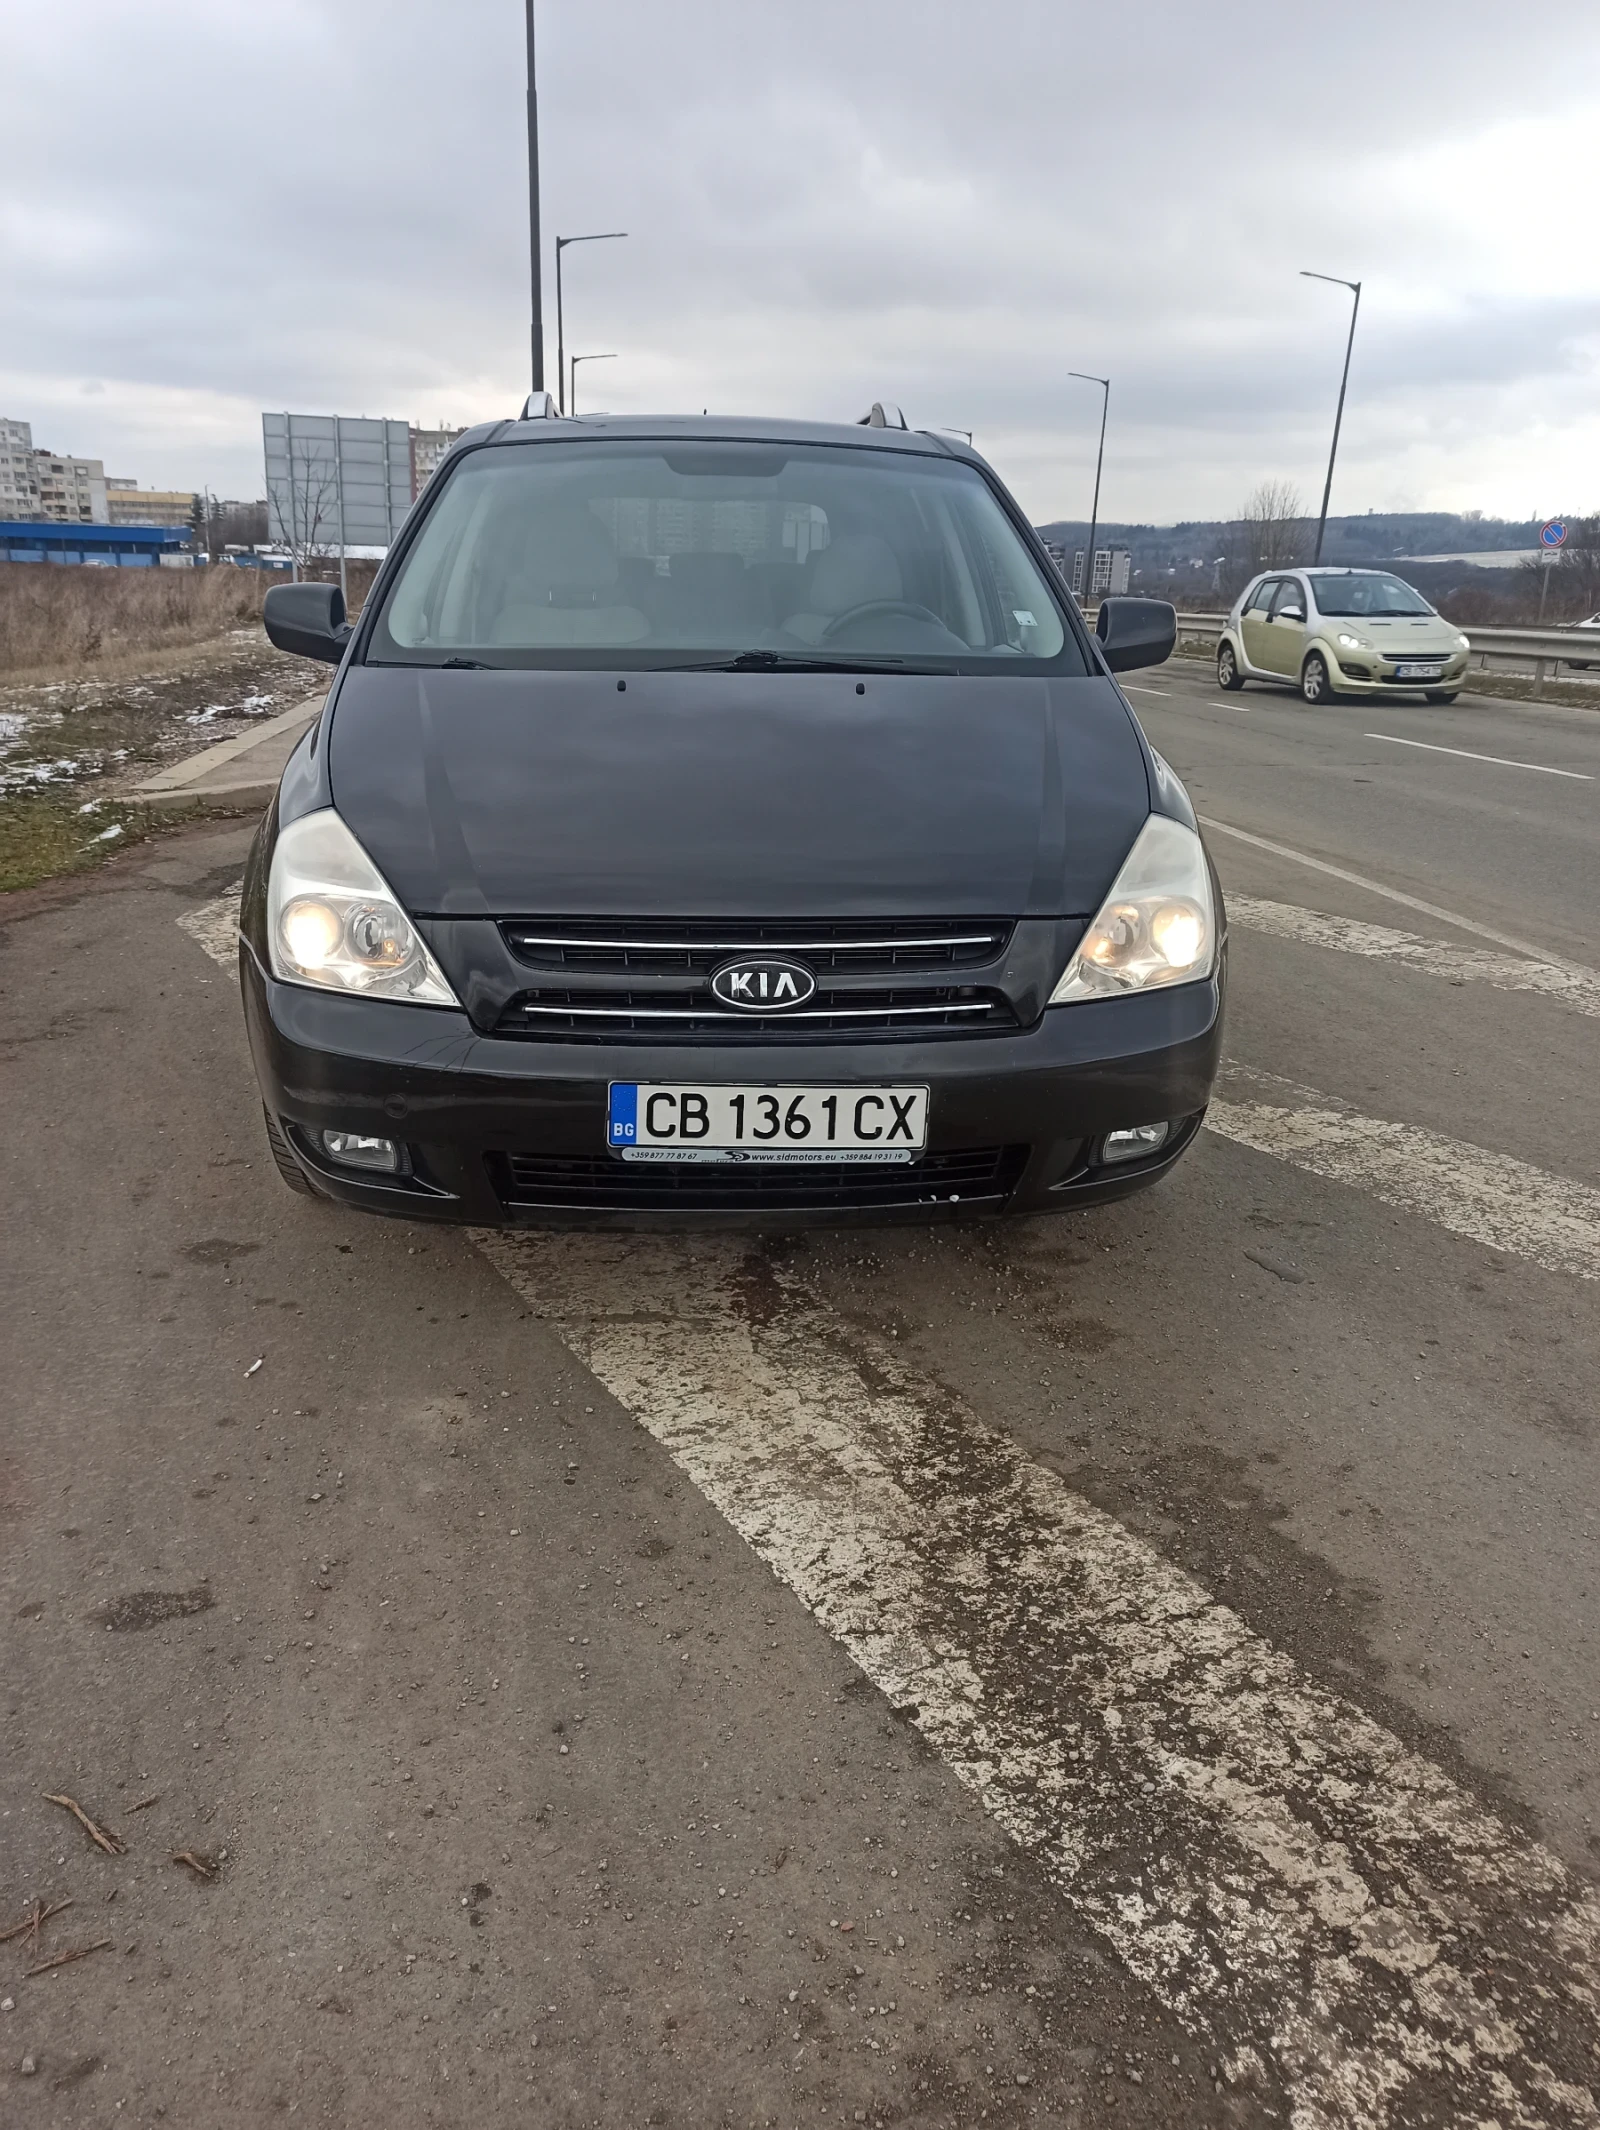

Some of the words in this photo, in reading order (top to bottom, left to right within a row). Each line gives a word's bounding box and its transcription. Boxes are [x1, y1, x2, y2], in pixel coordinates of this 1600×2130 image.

[729, 972, 799, 998] KIA
[645, 1092, 710, 1139] CB
[729, 1094, 838, 1140] 1361
[853, 1095, 917, 1141] CX
[613, 1123, 635, 1137] BG
[677, 1152, 687, 1160] 87
[751, 1153, 837, 1161] www.sidmotors.eu
